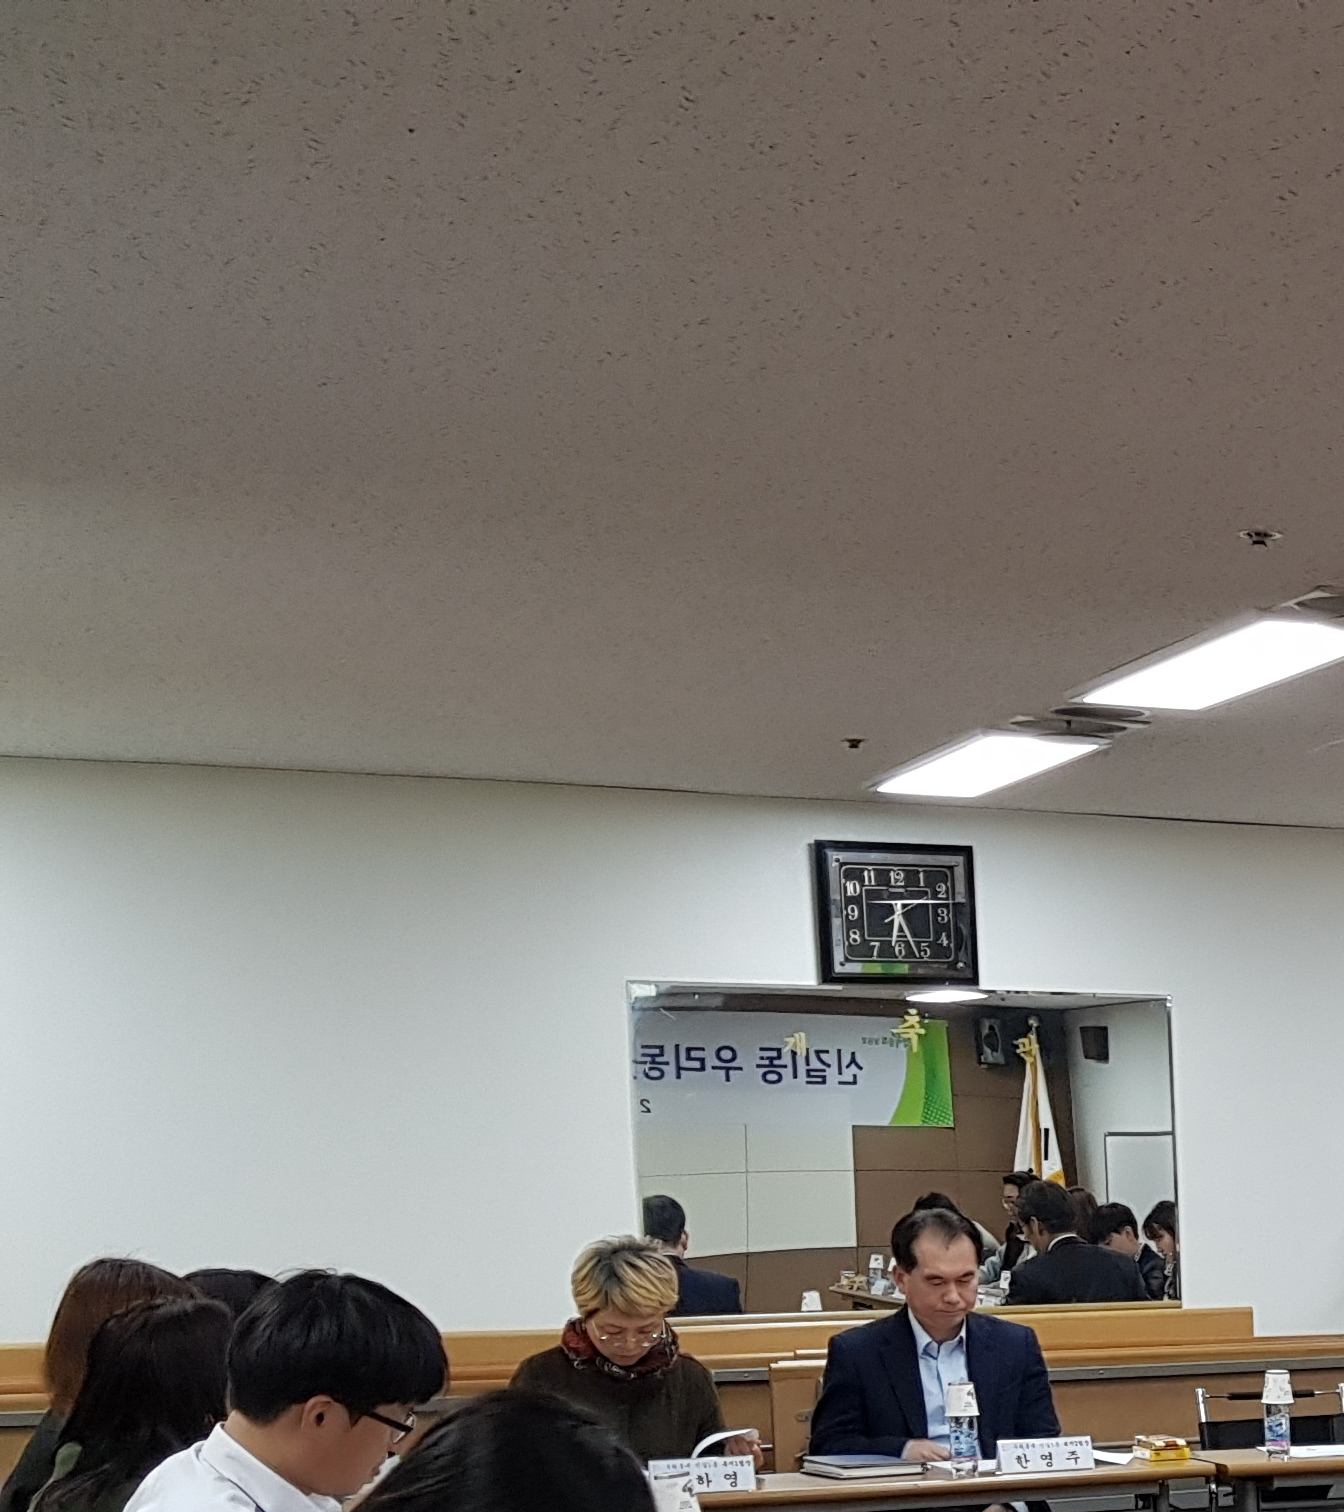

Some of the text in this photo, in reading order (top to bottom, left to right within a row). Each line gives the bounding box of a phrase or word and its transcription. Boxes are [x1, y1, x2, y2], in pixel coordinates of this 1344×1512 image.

[863, 870, 876, 885] 11
[890, 870, 905, 886] 12
[845, 881, 860, 896] 10
[936, 883, 947, 898] 2
[847, 905, 858, 920] 9
[937, 908, 948, 923] 3
[849, 929, 860, 945] 8
[936, 932, 948, 947] 4
[869, 942, 880, 958] 7
[894, 942, 905, 958] 6
[920, 943, 931, 958] 5
